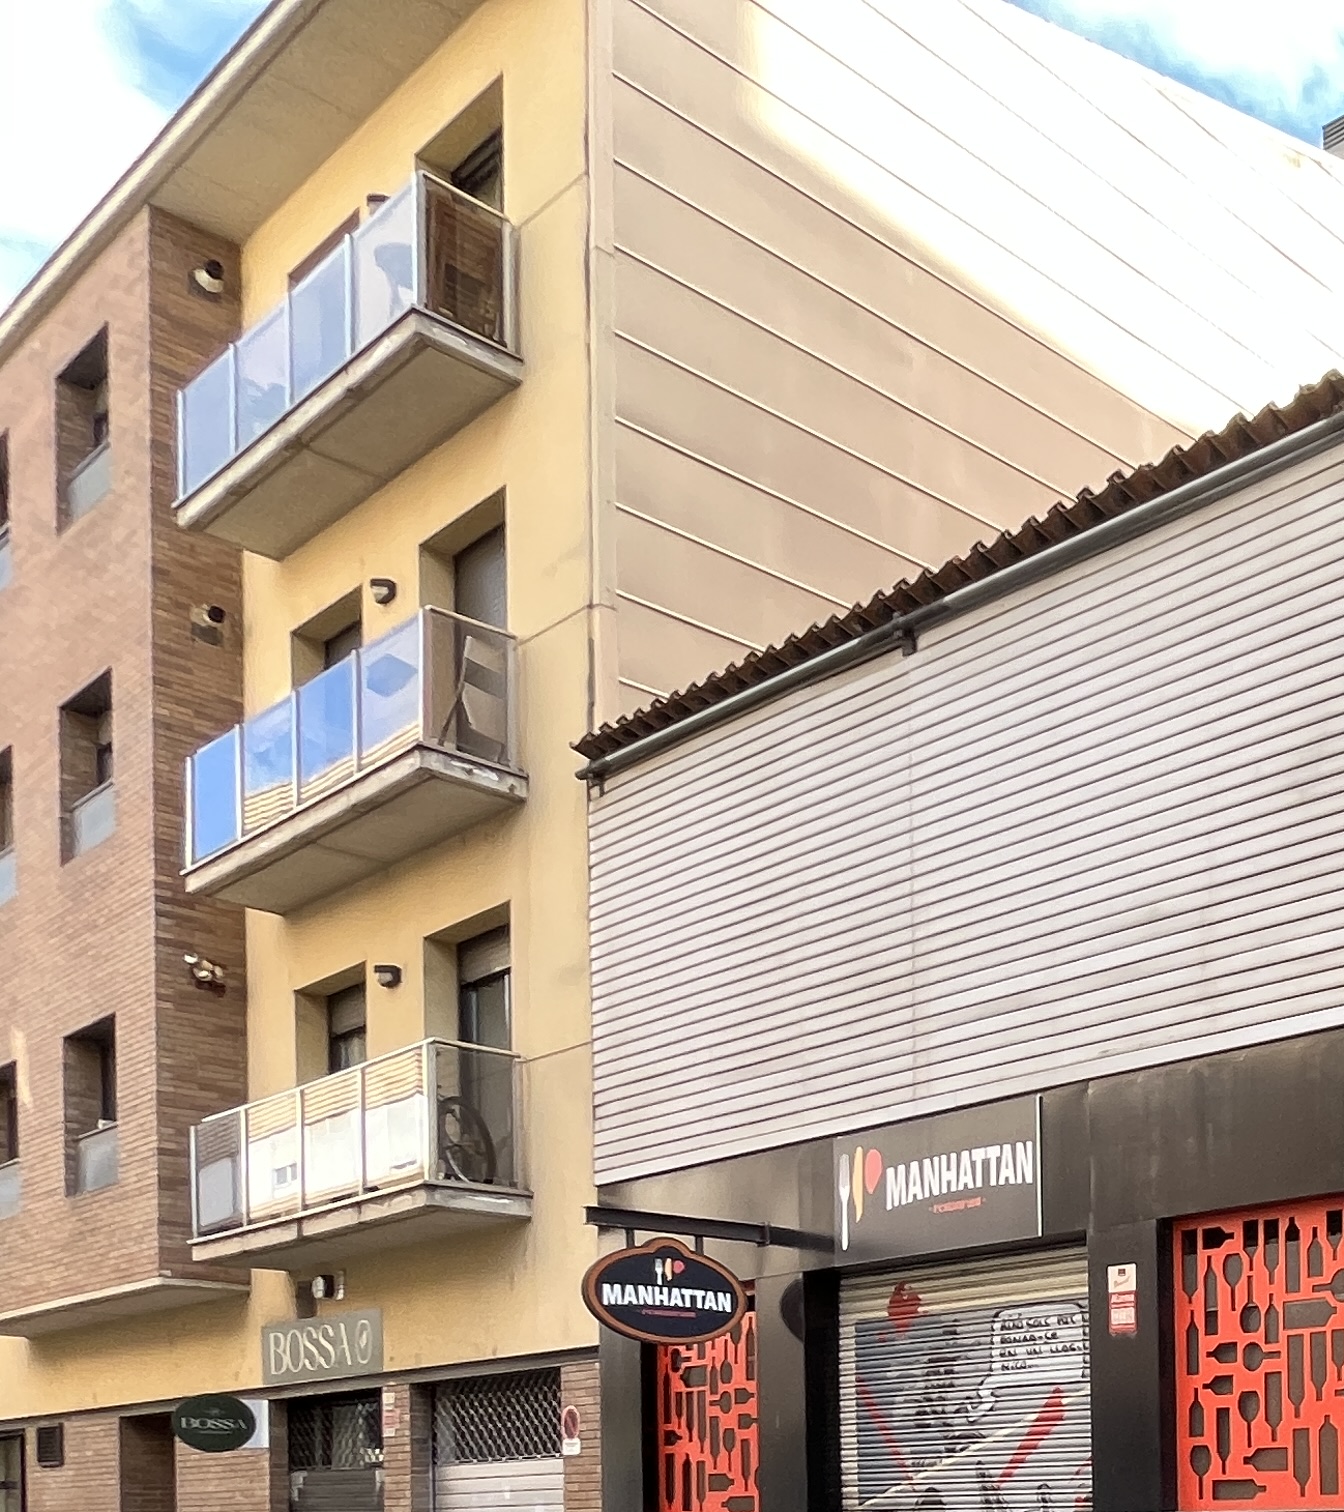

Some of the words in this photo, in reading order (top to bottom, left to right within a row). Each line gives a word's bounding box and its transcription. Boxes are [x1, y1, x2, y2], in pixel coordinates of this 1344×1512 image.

[885, 1140, 1034, 1211] MANHATTAN
[602, 1283, 732, 1313] MANHATTAN
[269, 1322, 352, 1375] BOSSA
[181, 1416, 248, 1430] BOSSA
